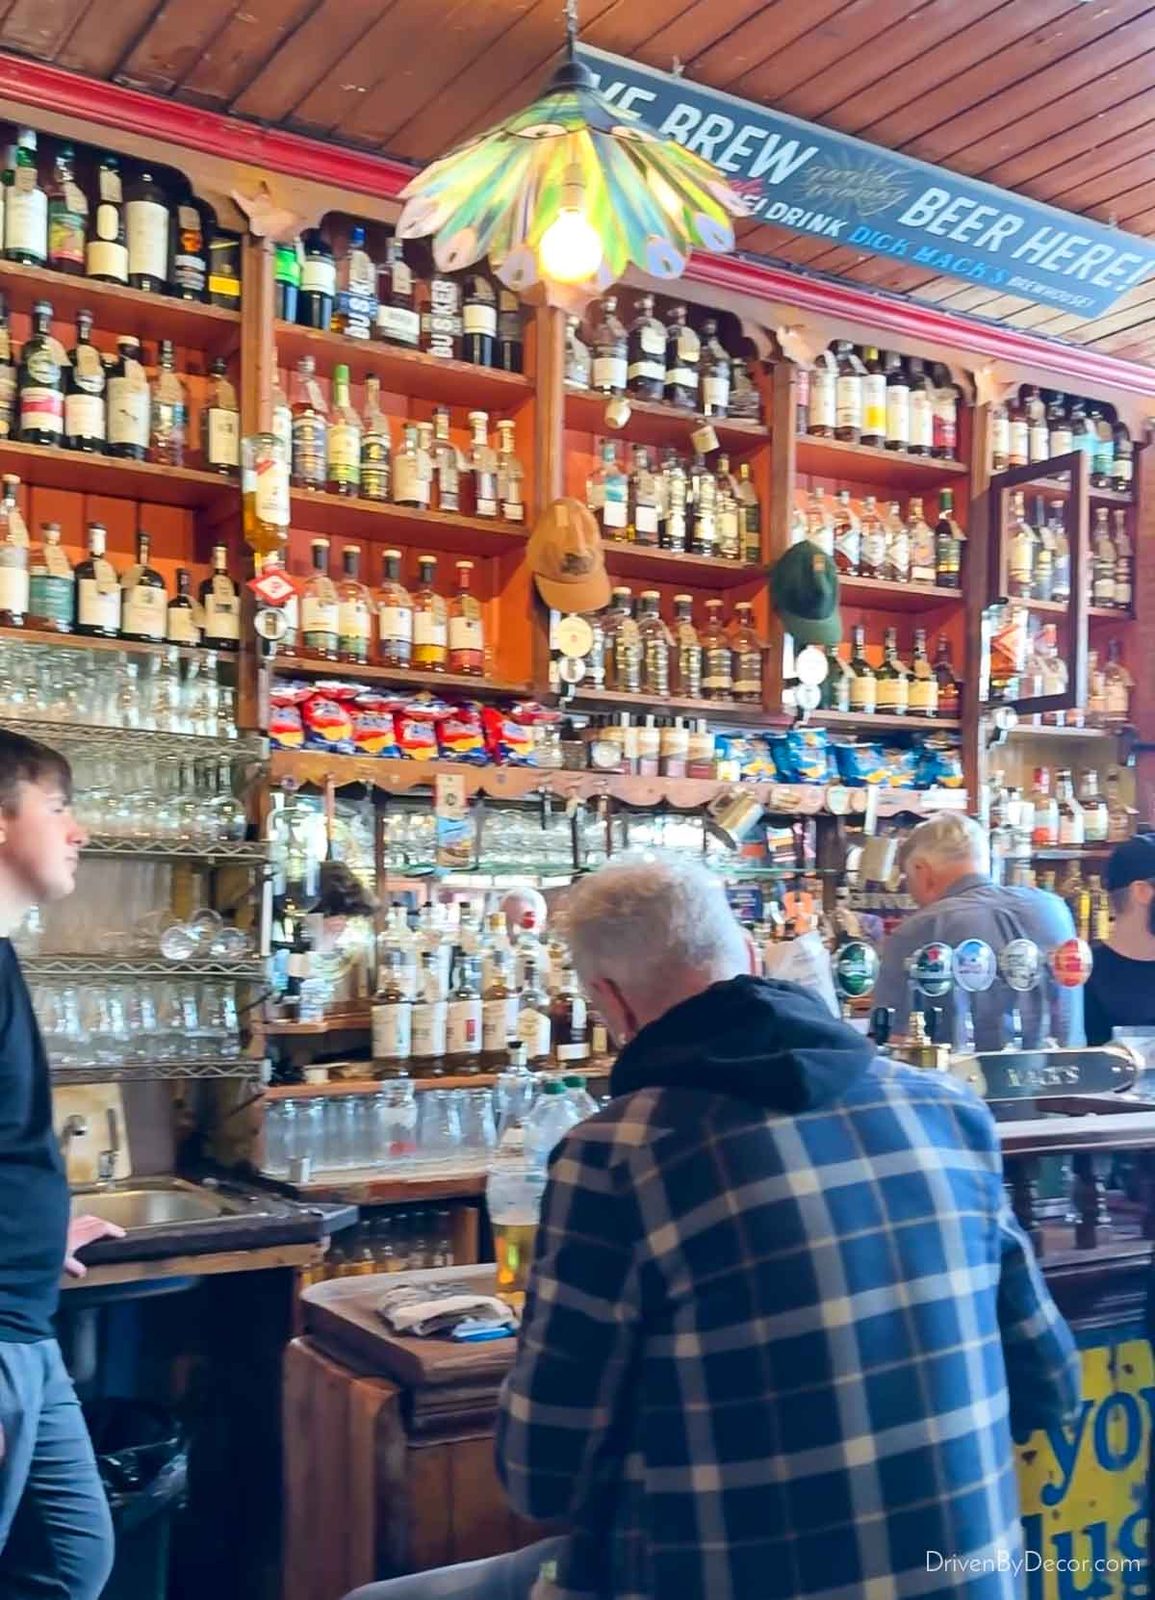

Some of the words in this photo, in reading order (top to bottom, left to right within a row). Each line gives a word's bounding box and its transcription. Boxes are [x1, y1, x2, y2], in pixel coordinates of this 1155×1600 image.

[658, 103, 819, 185] BREW
[898, 187, 1025, 252] BEER
[1010, 226, 1155, 291] HERE!
[764, 202, 849, 238] DRINK
[848, 226, 917, 256] DICK
[1041, 1386, 1152, 1506] yo
